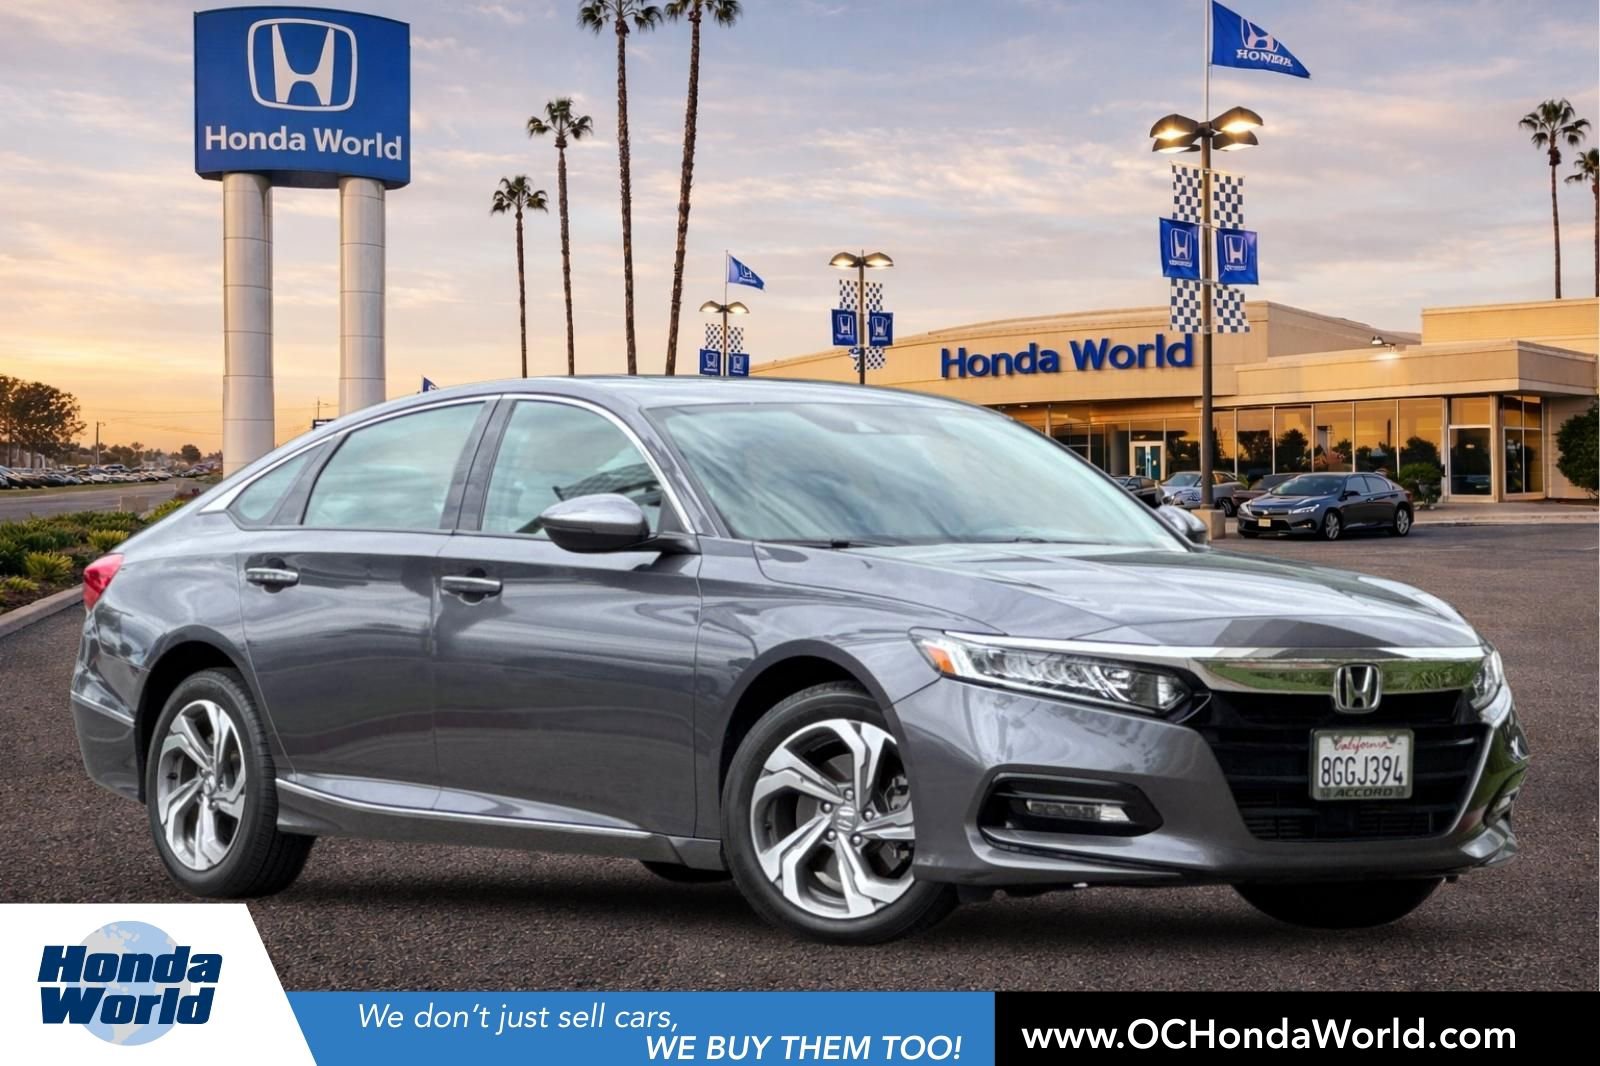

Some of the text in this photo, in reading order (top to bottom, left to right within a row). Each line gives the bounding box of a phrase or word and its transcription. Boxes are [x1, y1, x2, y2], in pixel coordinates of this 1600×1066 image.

[205, 125, 402, 161] Honda World
[940, 332, 1195, 378] Honda World
[1321, 755, 1404, 786] 8GGJ394
[1334, 788, 1393, 798] ACCORD
